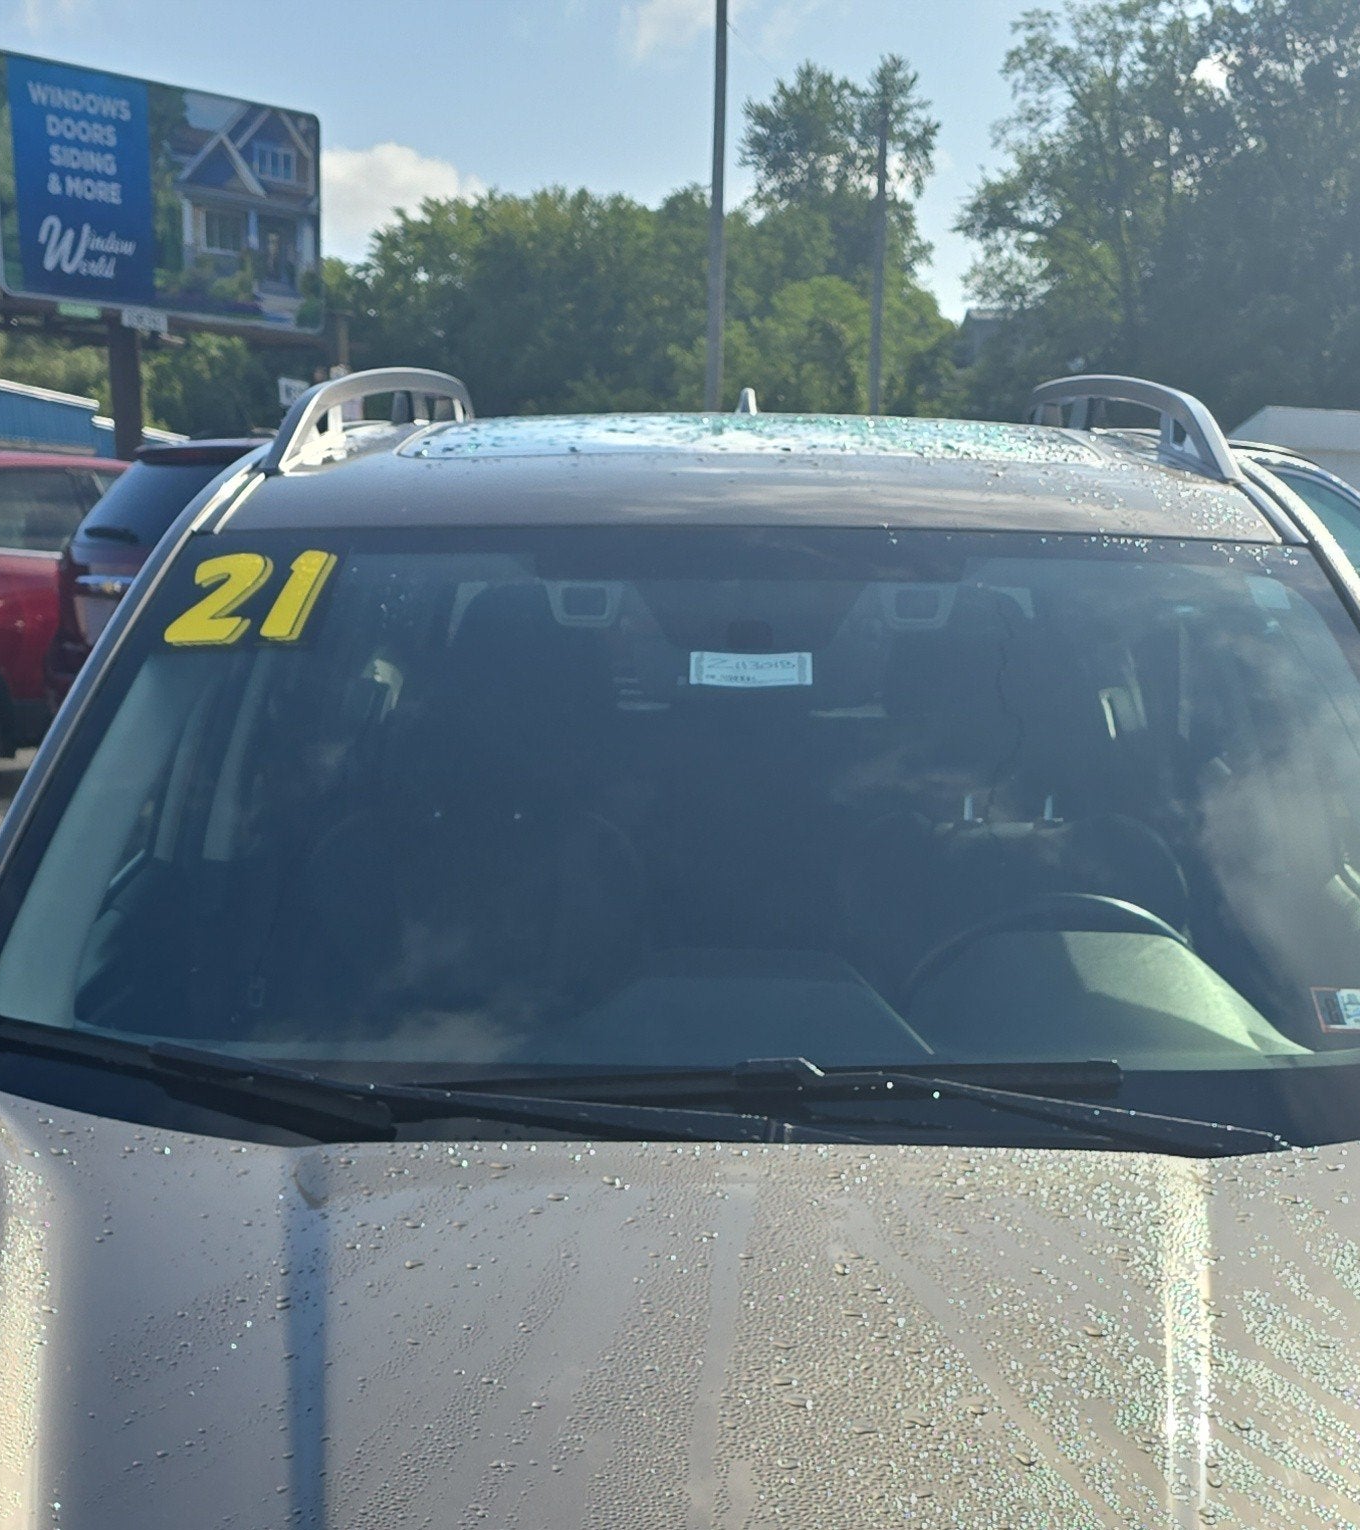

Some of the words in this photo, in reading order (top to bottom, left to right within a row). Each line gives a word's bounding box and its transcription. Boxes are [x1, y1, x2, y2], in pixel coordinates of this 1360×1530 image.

[27, 80, 132, 121] WINDOWS
[46, 114, 117, 147] DOORS
[49, 143, 117, 176] SIDING
[47, 172, 62, 195] &
[65, 175, 122, 205] MORE
[164, 549, 338, 646] 21
